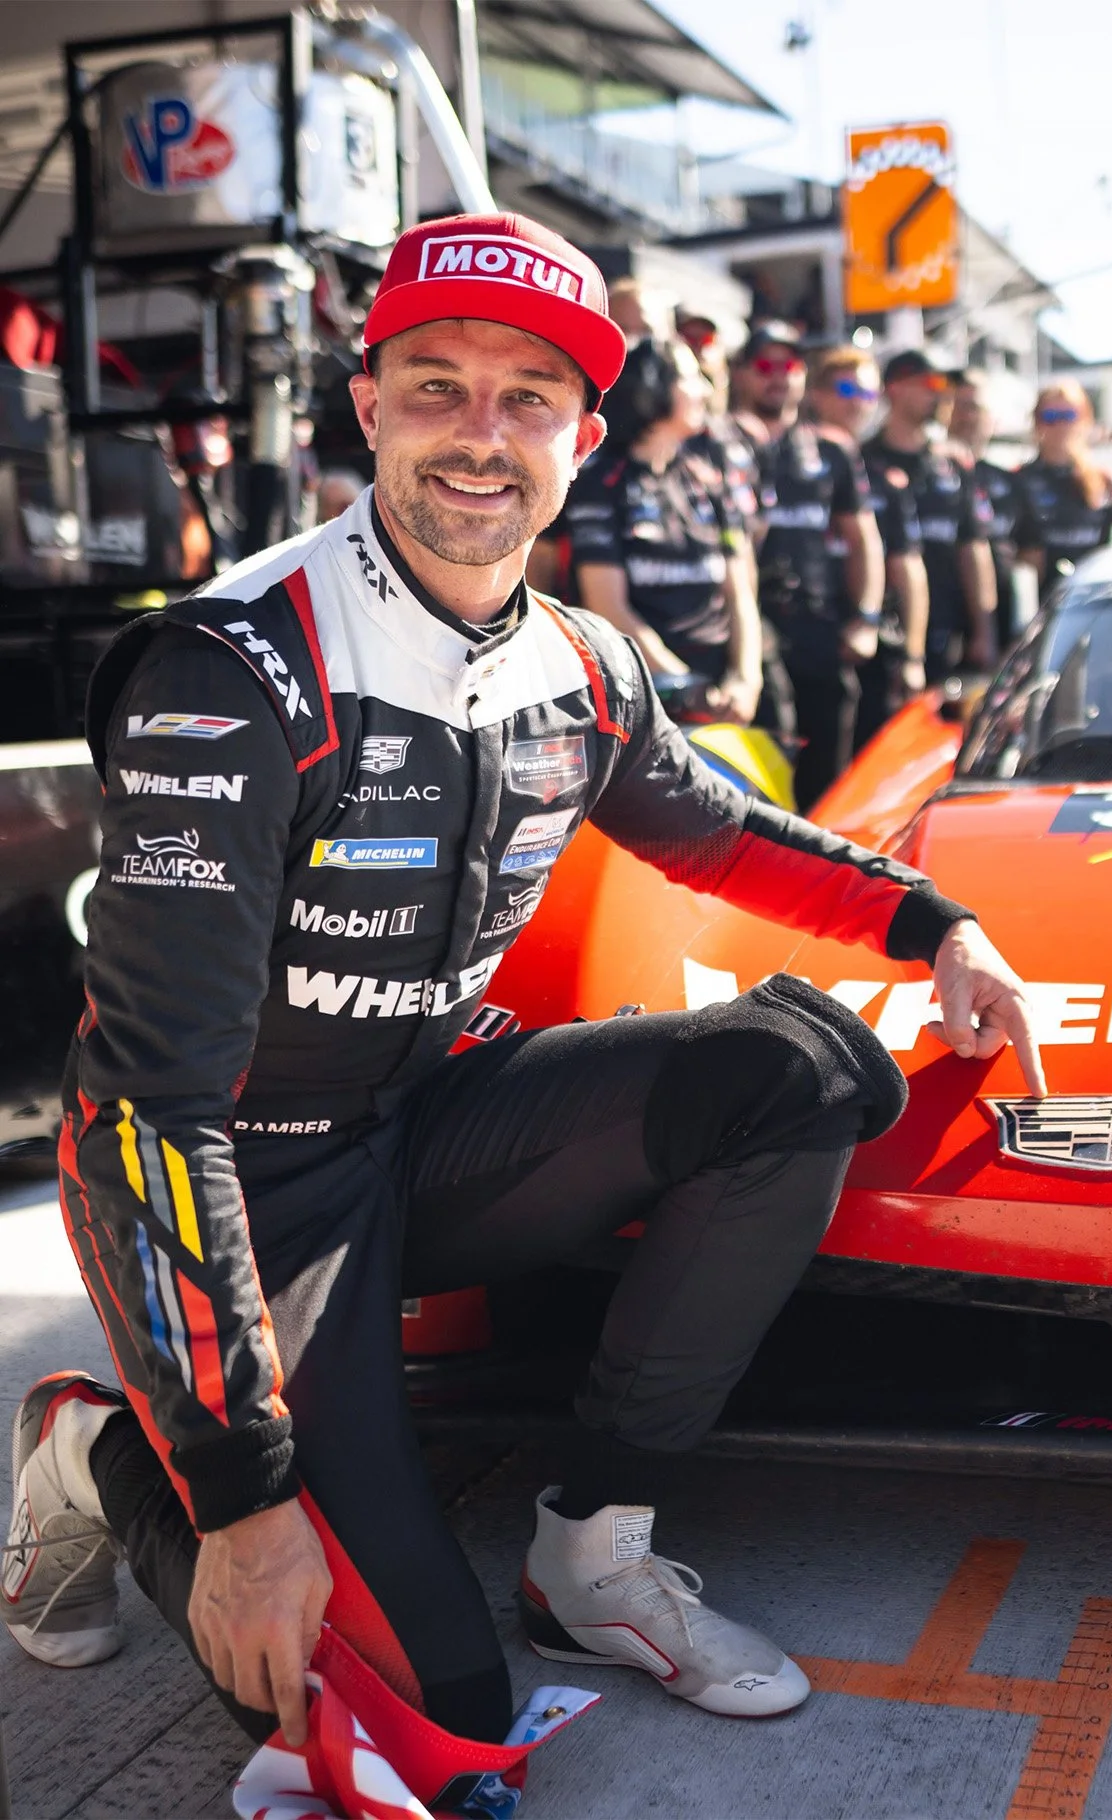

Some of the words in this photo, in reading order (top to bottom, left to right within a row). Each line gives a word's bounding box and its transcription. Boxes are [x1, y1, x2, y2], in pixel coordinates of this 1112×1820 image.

[124, 99, 192, 189] VP
[433, 245, 578, 302] MOTUL
[119, 768, 244, 802] WHELEN
[352, 847, 426, 861] MICHELIN
[111, 875, 127, 883] FOR
[127, 876, 186, 887] PARKINSON'S
[188, 880, 236, 893] RESEARCH
[289, 898, 389, 938] Mobil
